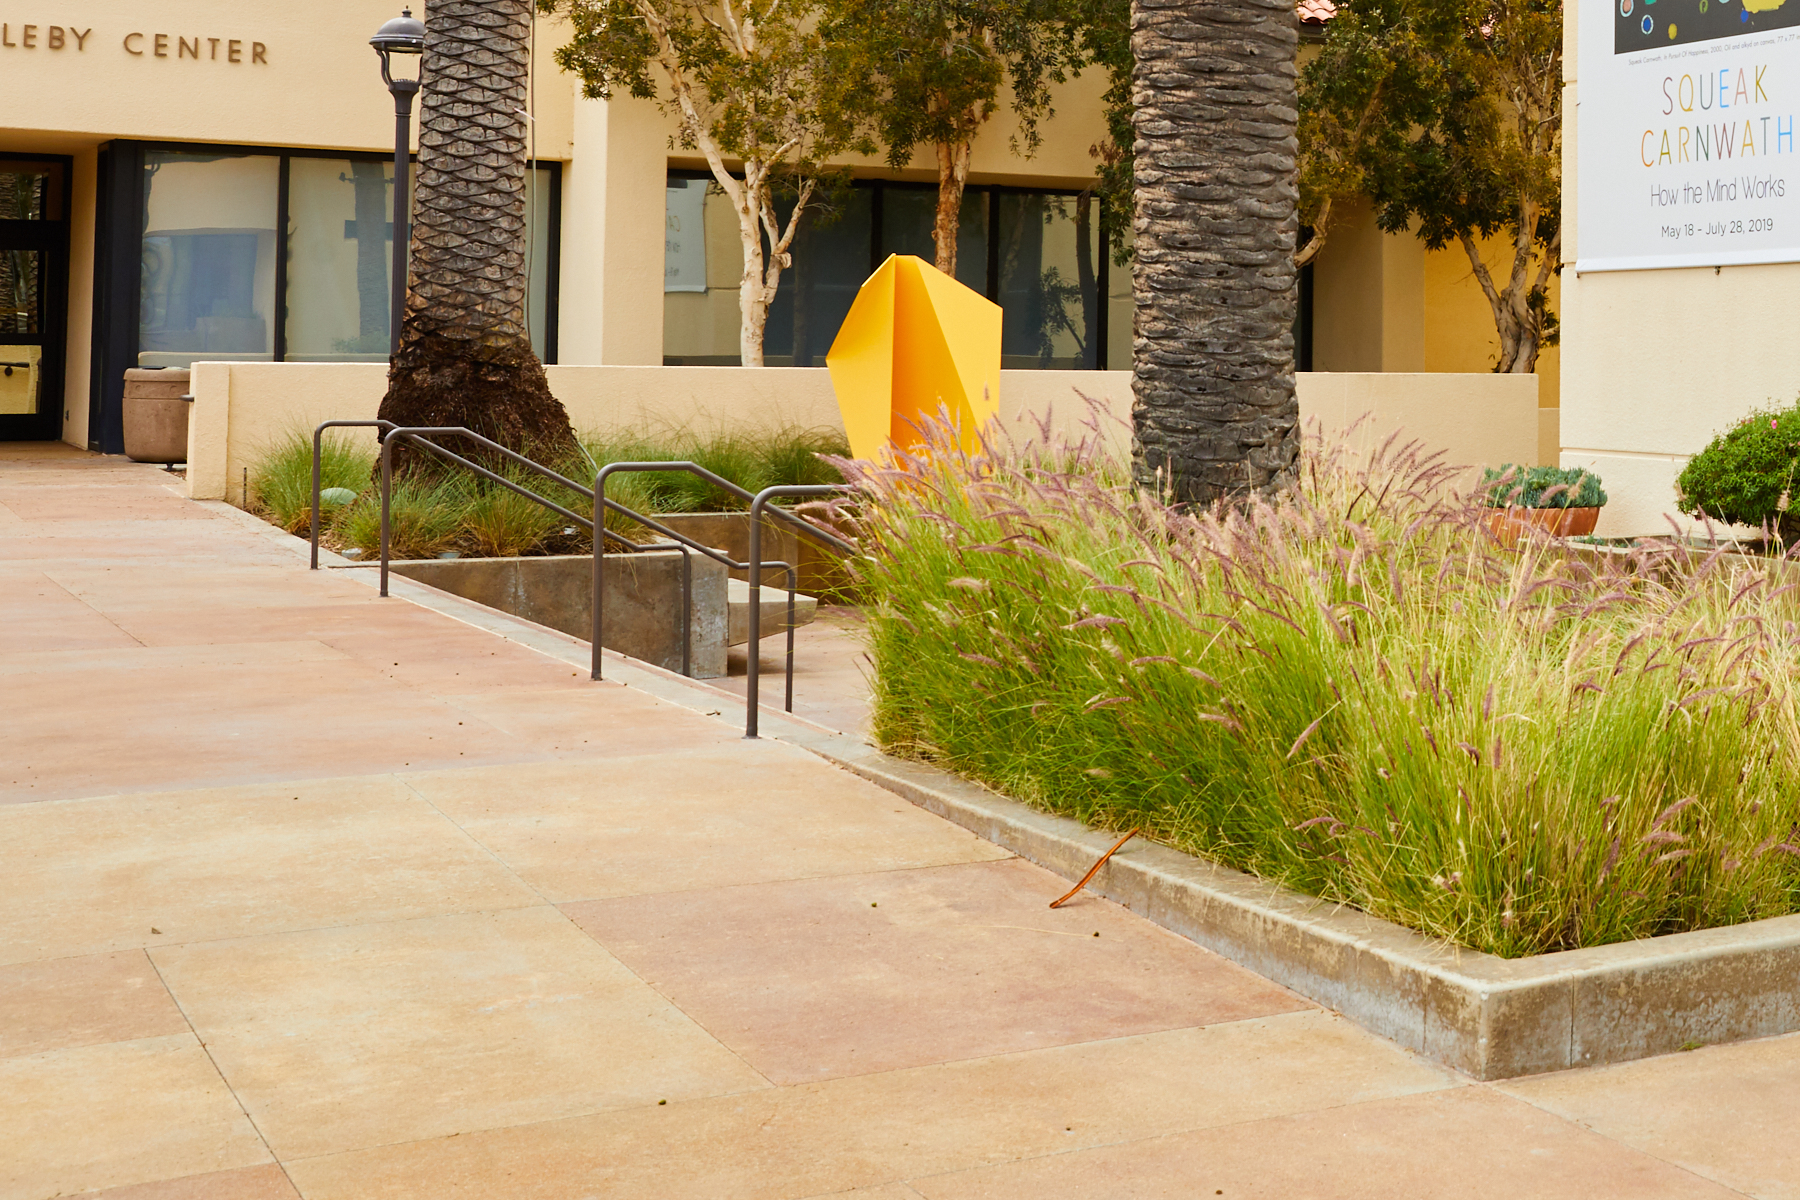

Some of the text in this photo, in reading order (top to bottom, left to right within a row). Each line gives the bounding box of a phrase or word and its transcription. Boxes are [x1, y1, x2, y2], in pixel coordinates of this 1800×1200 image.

[2, 22, 268, 64] LEBY CENTER
[1662, 64, 1768, 115] SQUEAK
[1641, 115, 1793, 167] CARNWATH
[1650, 174, 1785, 206] How the Mind Works
[1662, 225, 1681, 239] May
[1684, 223, 1694, 236] 18
[1706, 222, 1726, 236] July
[1730, 220, 1745, 234] 28,
[1748, 218, 1773, 232] 2019
